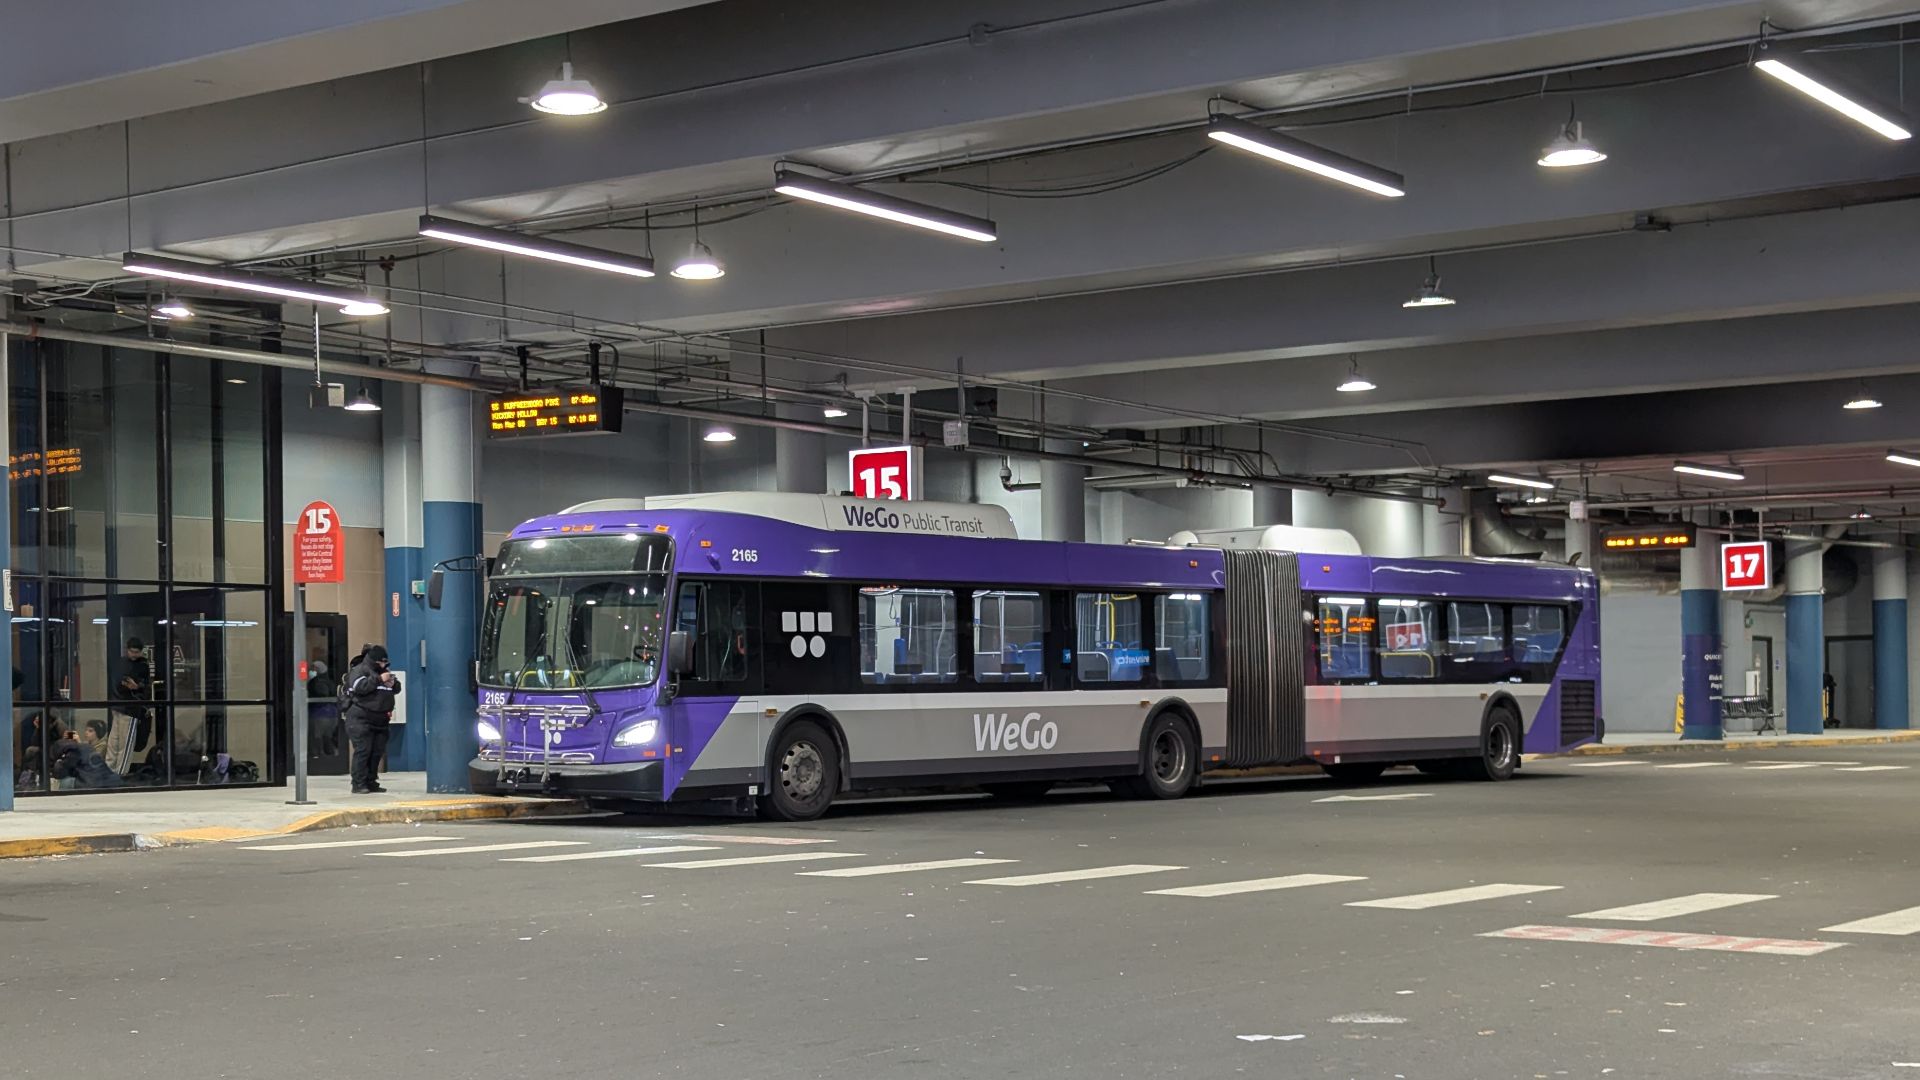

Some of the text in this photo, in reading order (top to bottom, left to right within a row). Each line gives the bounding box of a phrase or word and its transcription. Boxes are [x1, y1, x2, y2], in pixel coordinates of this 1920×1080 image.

[545, 398, 560, 406] PIKE
[492, 410, 538, 420] HICKORY HOLLOW
[860, 466, 902, 499] 15
[306, 508, 331, 534] 15
[843, 505, 984, 533] WeGo Public Transit
[732, 548, 758, 562] 2165
[1730, 553, 1760, 578] 17
[485, 692, 506, 705] 2165
[974, 712, 1058, 751] WeGo
[1503, 926, 1825, 950] STOP
